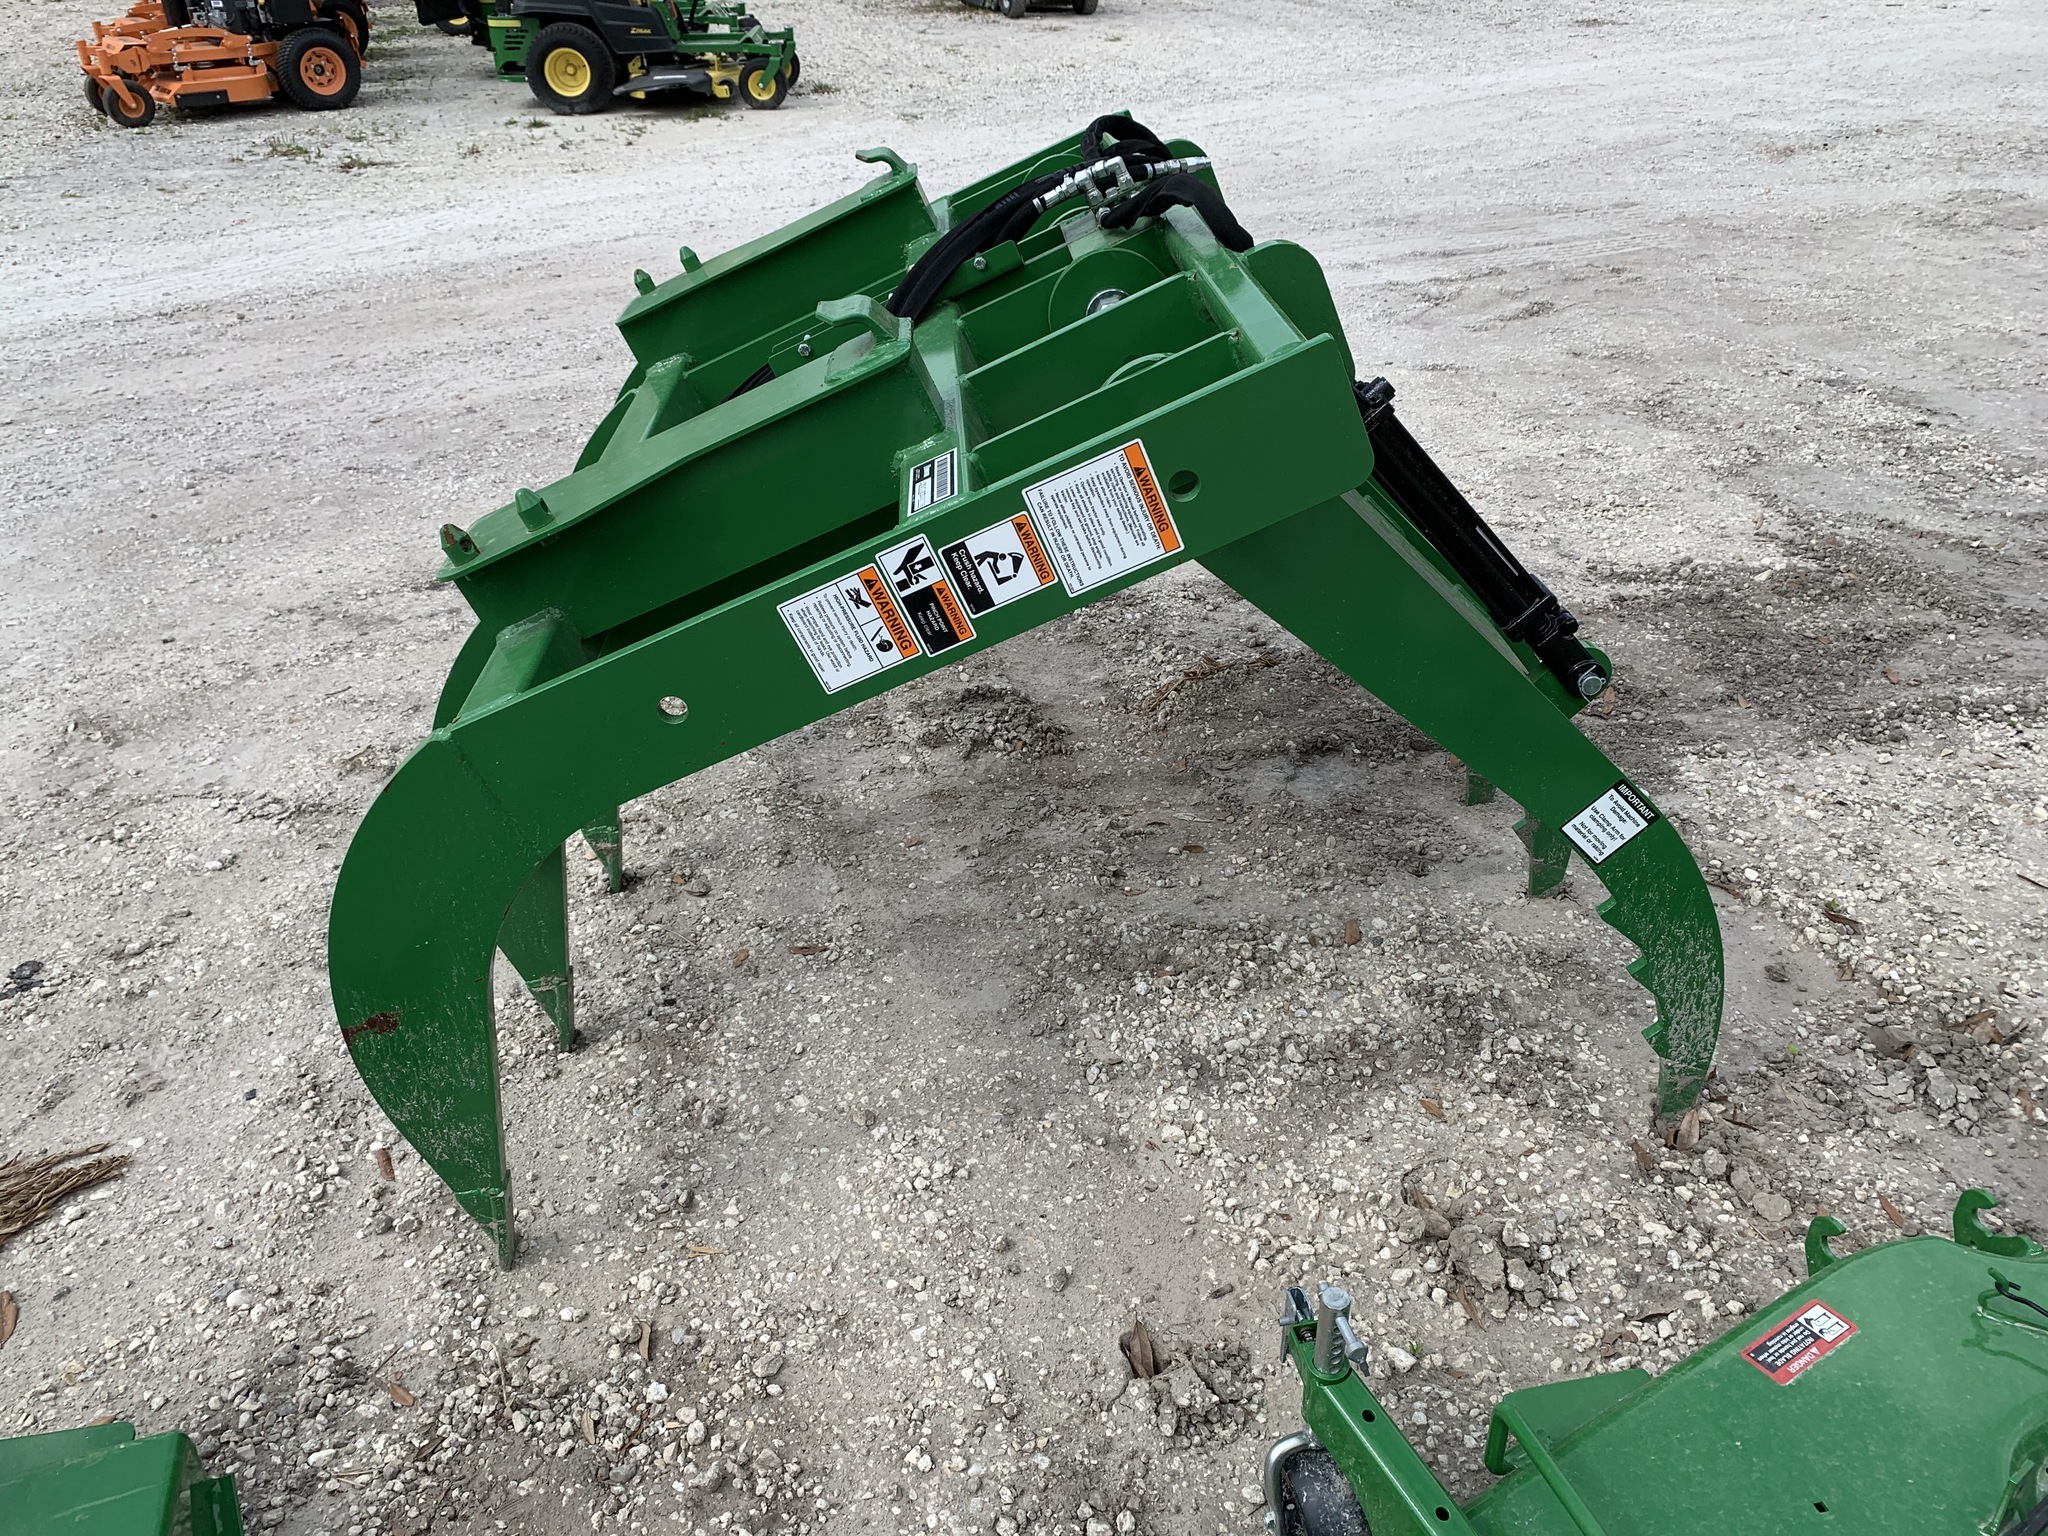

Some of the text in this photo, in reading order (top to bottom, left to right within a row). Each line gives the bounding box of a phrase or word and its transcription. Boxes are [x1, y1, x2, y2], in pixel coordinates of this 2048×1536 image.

[1120, 461, 1131, 479] AVOID
[1128, 479, 1142, 503] SERIOUS
[1138, 502, 1149, 522] INJURY
[1138, 474, 1169, 532] WARNING
[1036, 501, 1044, 512] CAN
[1041, 512, 1053, 531] RESULT
[1052, 537, 1063, 554] INJURY
[1037, 488, 1049, 509] FAILURE
[1049, 516, 1062, 537] FOLLOW
[1059, 537, 1069, 552] THESE
[1065, 552, 1084, 586] INSTRUCTIONS
[949, 551, 964, 570] Keep
[958, 569, 973, 590] Clear.
[957, 548, 973, 569] Crush
[968, 569, 985, 594] hazard.
[1019, 529, 1050, 580] WARNING
[870, 587, 912, 650] WARNING
[916, 611, 926, 624] Keep
[922, 624, 932, 636] clear
[925, 610, 939, 631] HAZARD
[928, 602, 948, 633] PINCH POINT
[940, 593, 967, 635] WARNING
[853, 630, 863, 643] FLUID
[860, 643, 874, 662] HAZARD
[1612, 799, 1626, 812] Avoid
[1623, 810, 1641, 827] Machine
[1617, 783, 1654, 820] IMPORTANT
[1578, 821, 1608, 849] Not for moving
[1590, 805, 1601, 815] Use
[1597, 813, 1613, 827] Clamp
[1610, 825, 1621, 835] Arm
[1570, 823, 1588, 839] material
[1589, 842, 1605, 856] raking
[1774, 1336, 1814, 1366] ROTATING BLADE
[1786, 1351, 1815, 1373] DANGER
